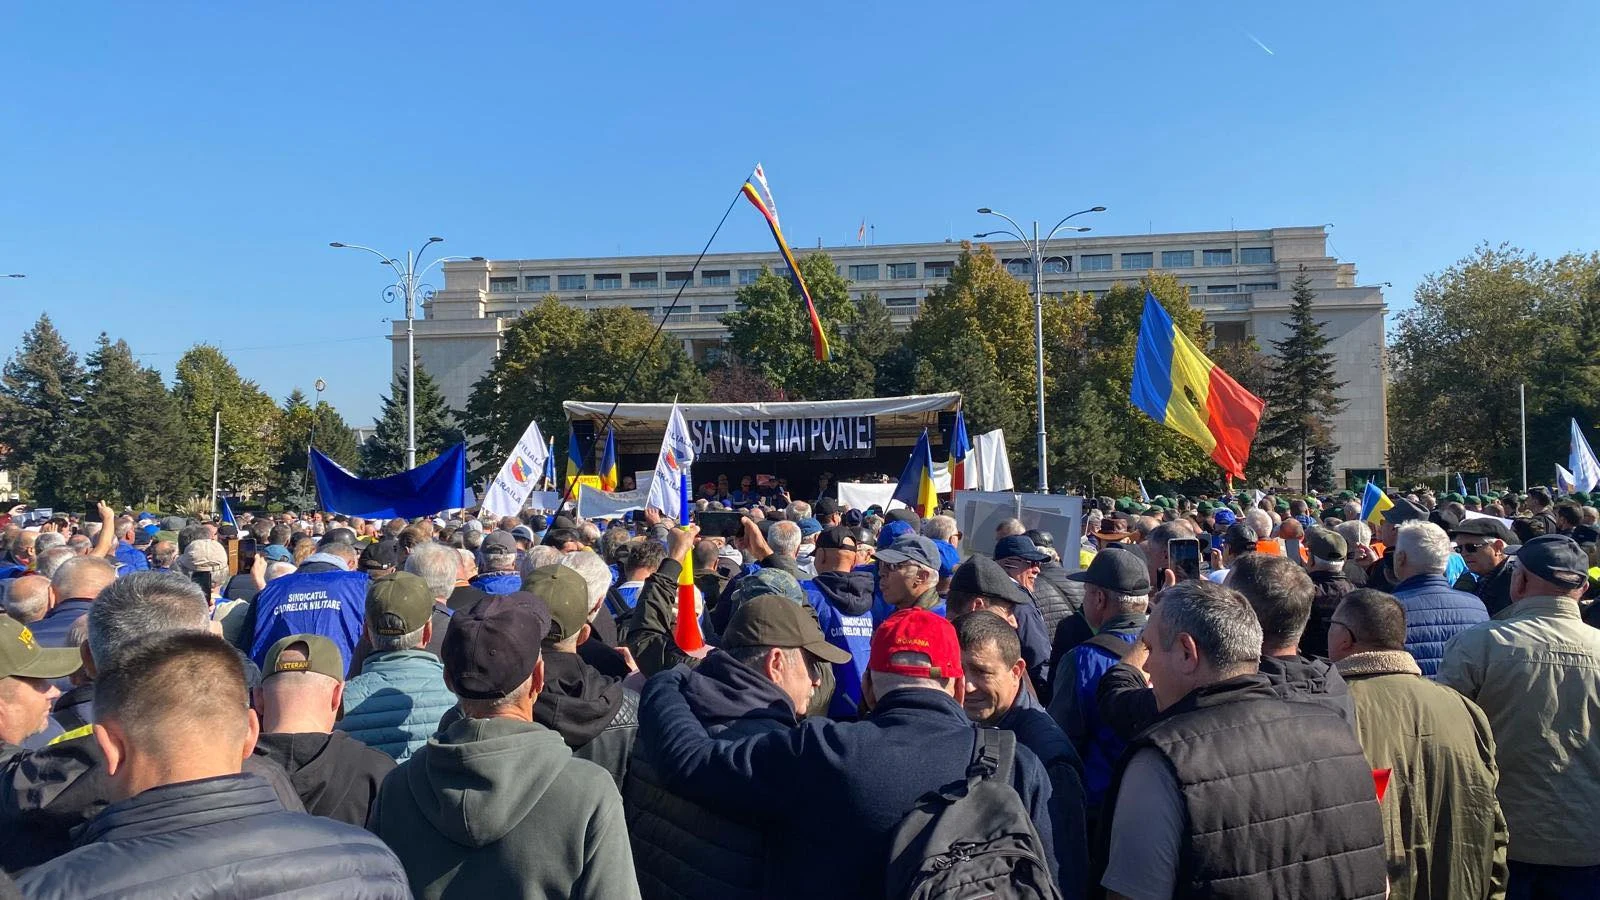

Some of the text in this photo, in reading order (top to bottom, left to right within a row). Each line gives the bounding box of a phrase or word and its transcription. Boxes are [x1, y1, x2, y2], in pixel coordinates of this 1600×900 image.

[719, 419, 743, 454] NU
[747, 419, 771, 454] SE
[775, 418, 806, 453] MAI
[811, 416, 873, 451] POATE!
[288, 591, 328, 602] SINDICATUL
[273, 600, 342, 616] CADRELOR MILITARE
[279, 661, 308, 670] VETERAN
